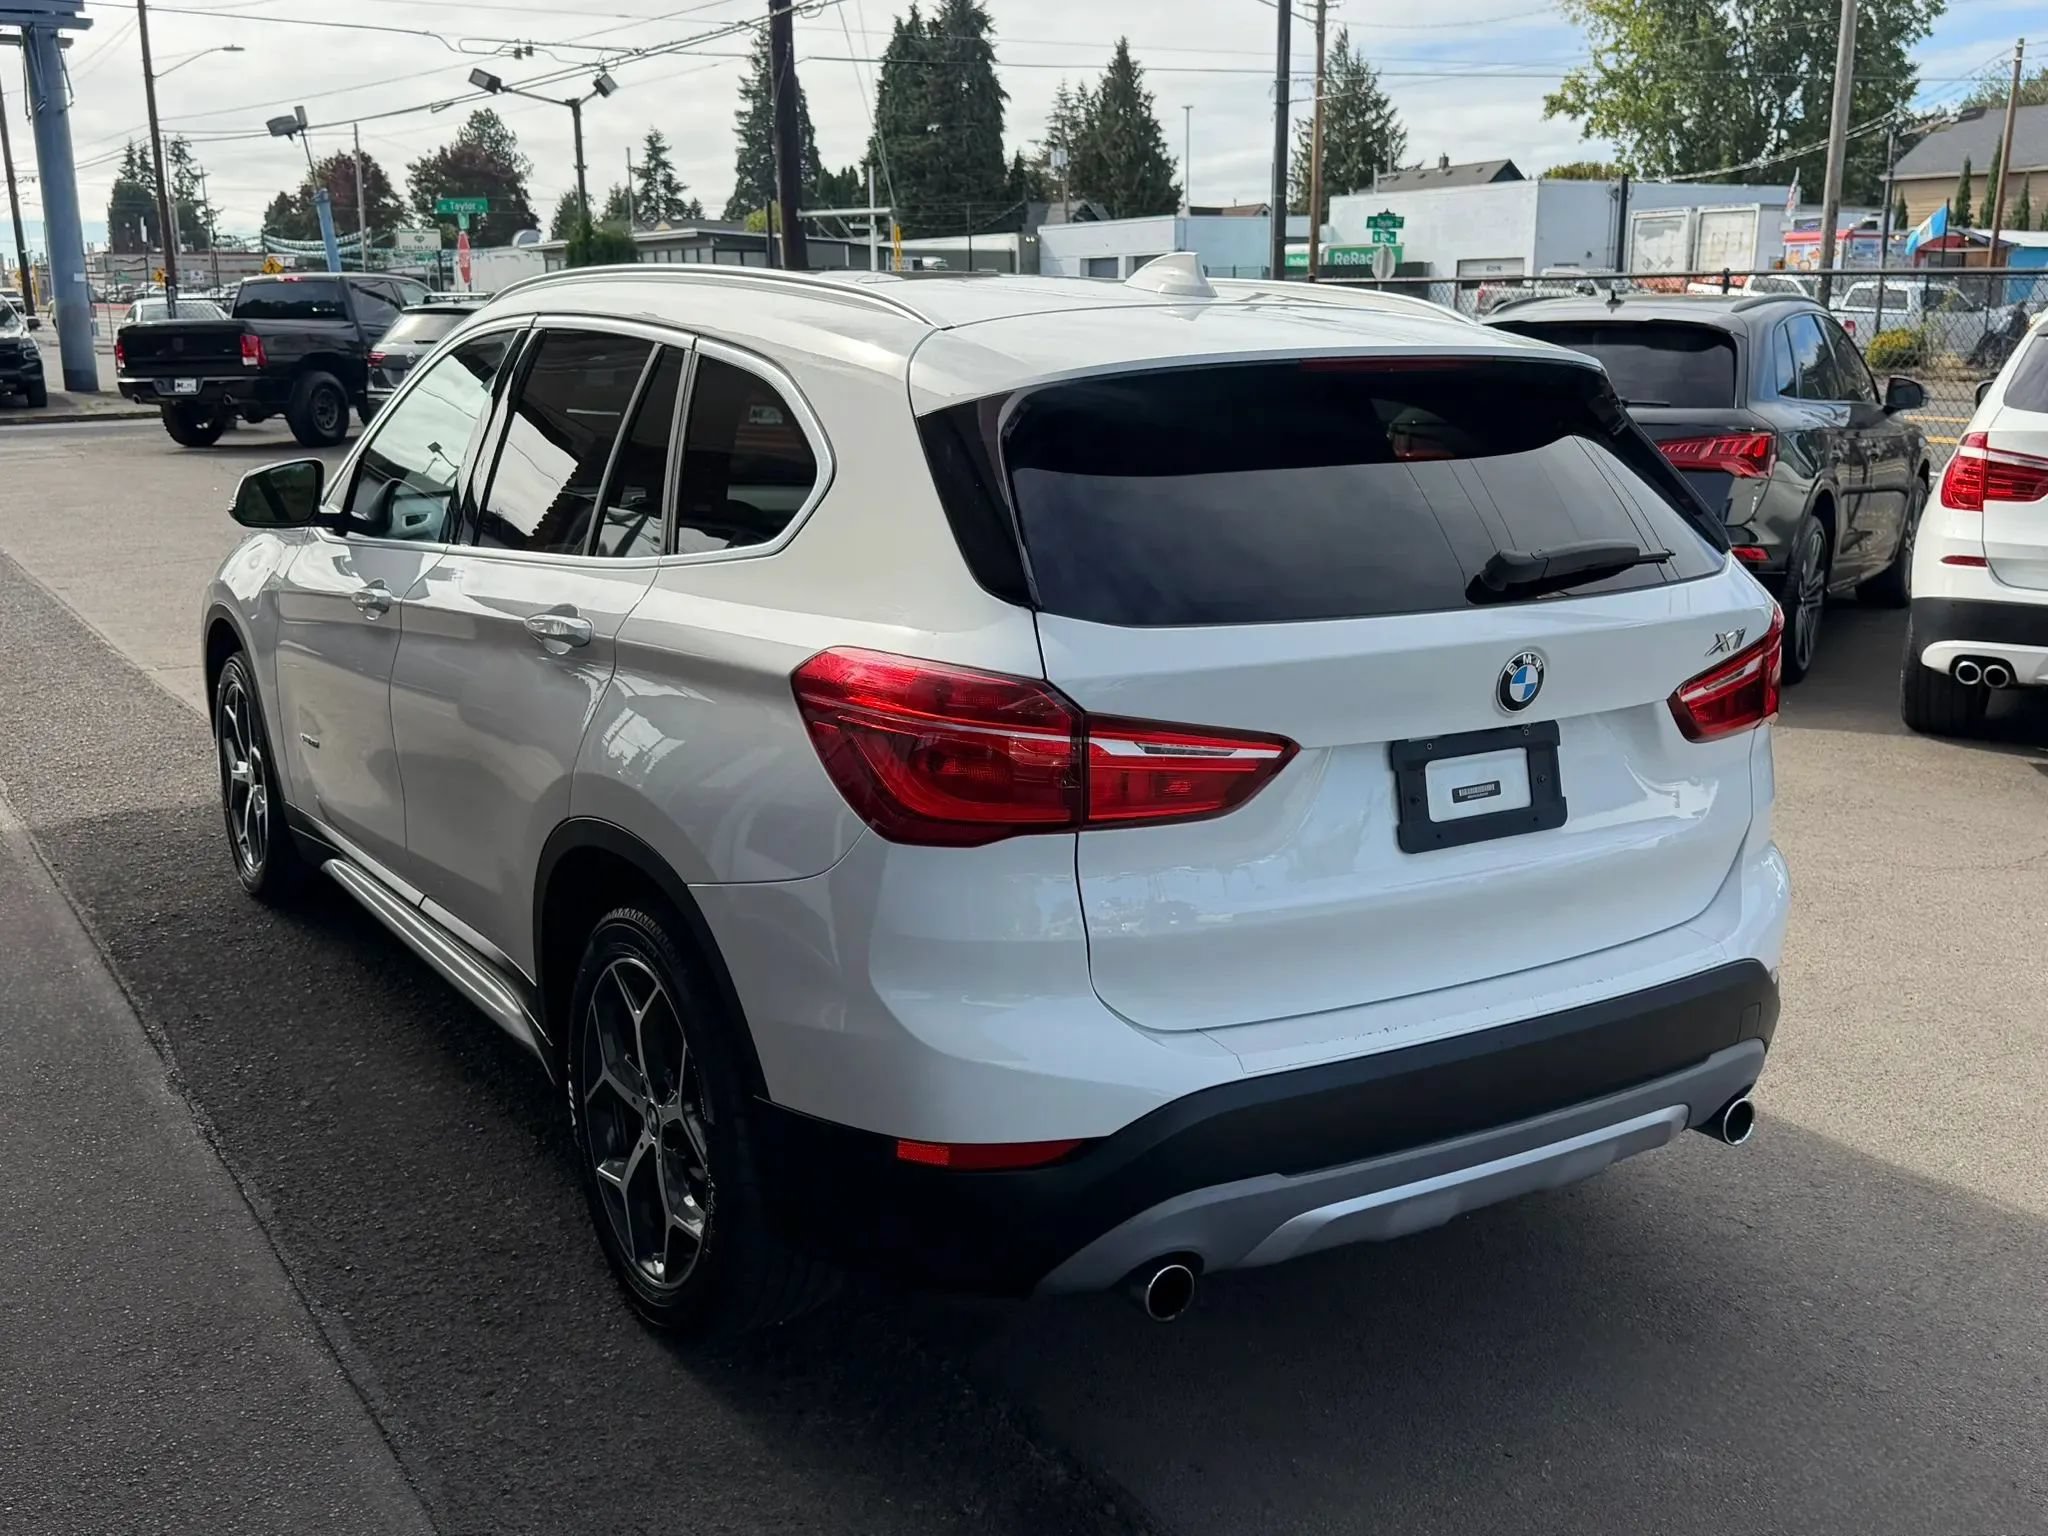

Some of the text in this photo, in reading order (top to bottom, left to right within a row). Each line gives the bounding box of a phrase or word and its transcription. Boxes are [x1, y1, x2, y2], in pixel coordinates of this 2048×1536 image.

[449, 201, 476, 212] Taylor
[1704, 628, 1746, 656] X1
[1507, 654, 1543, 675] BMW
